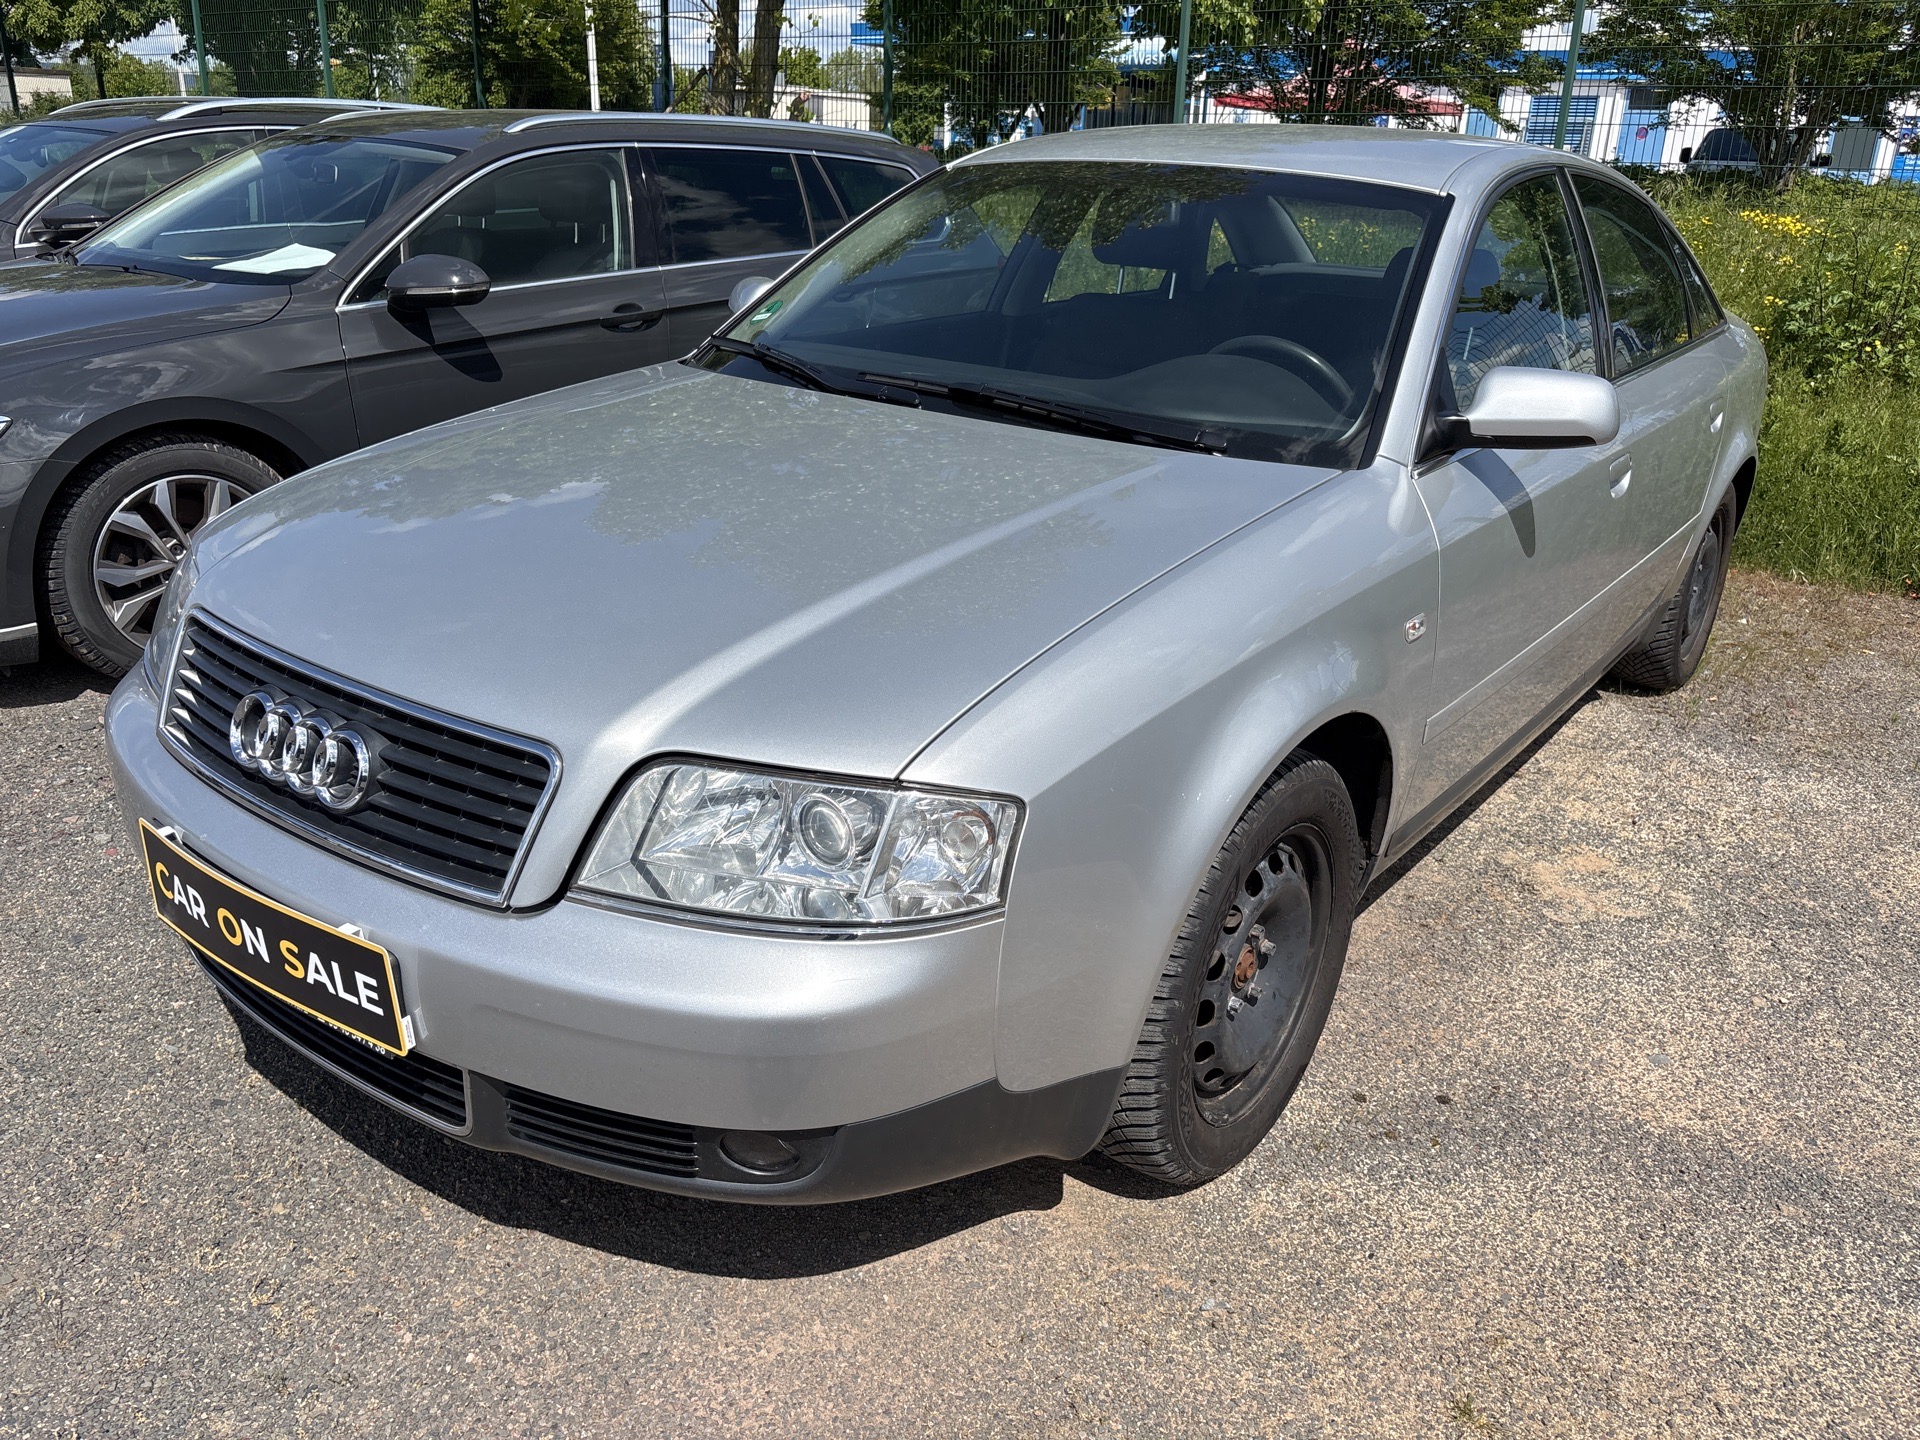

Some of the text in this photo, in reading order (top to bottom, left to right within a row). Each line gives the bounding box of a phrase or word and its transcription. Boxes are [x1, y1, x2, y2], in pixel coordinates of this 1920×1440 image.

[155, 861, 384, 1016] CAR ON SALE
